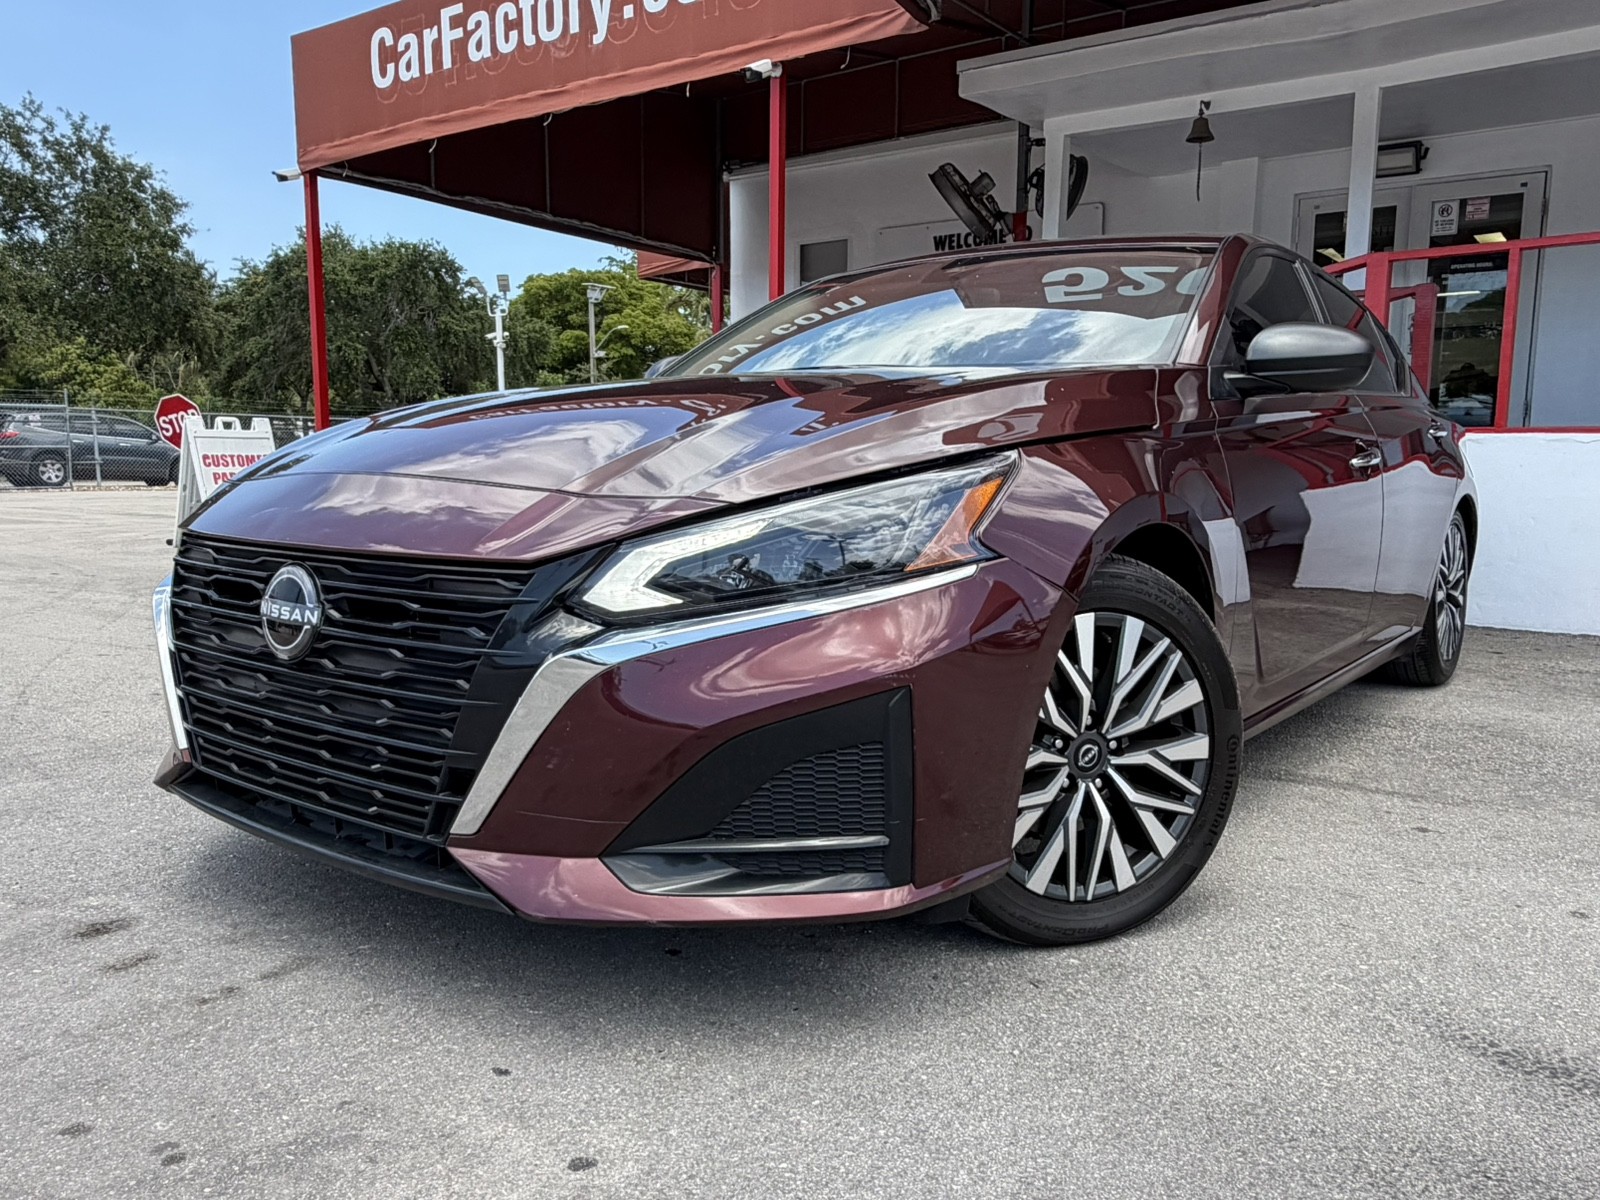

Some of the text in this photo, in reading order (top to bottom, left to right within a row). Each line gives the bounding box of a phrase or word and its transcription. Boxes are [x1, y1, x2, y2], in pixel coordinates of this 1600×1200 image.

[370, 0, 697, 89] CarFactory.
[202, 453, 267, 468] CUSTOM
[260, 599, 318, 626] NISSAN
[1207, 733, 1241, 836] Continental
